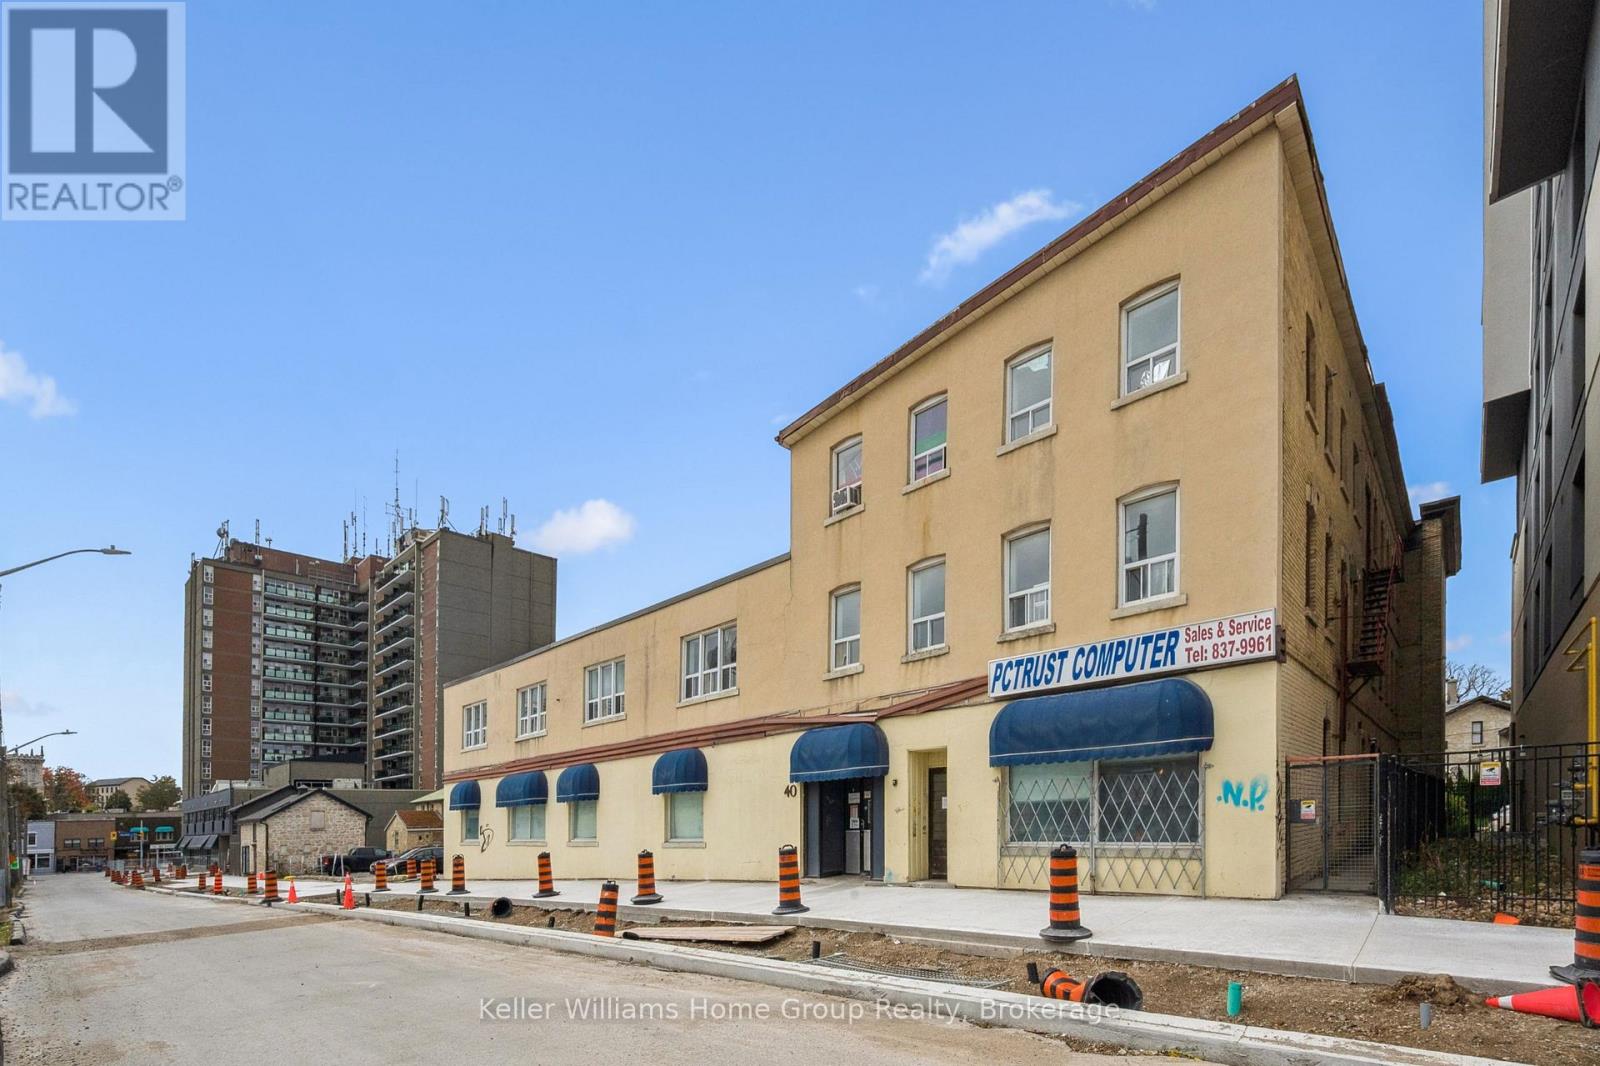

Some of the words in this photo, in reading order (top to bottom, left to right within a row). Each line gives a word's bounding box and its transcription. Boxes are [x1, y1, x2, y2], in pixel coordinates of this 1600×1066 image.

[1184, 625, 1213, 643] Sales
[1217, 621, 1225, 638] &
[1228, 615, 1272, 636] Service
[991, 650, 1068, 693] PCTRUST
[1072, 630, 1180, 681] COMPUTER
[1184, 645, 1208, 663] Tel:
[1212, 633, 1272, 660] 837-9961
[784, 784, 797, 798] 40
